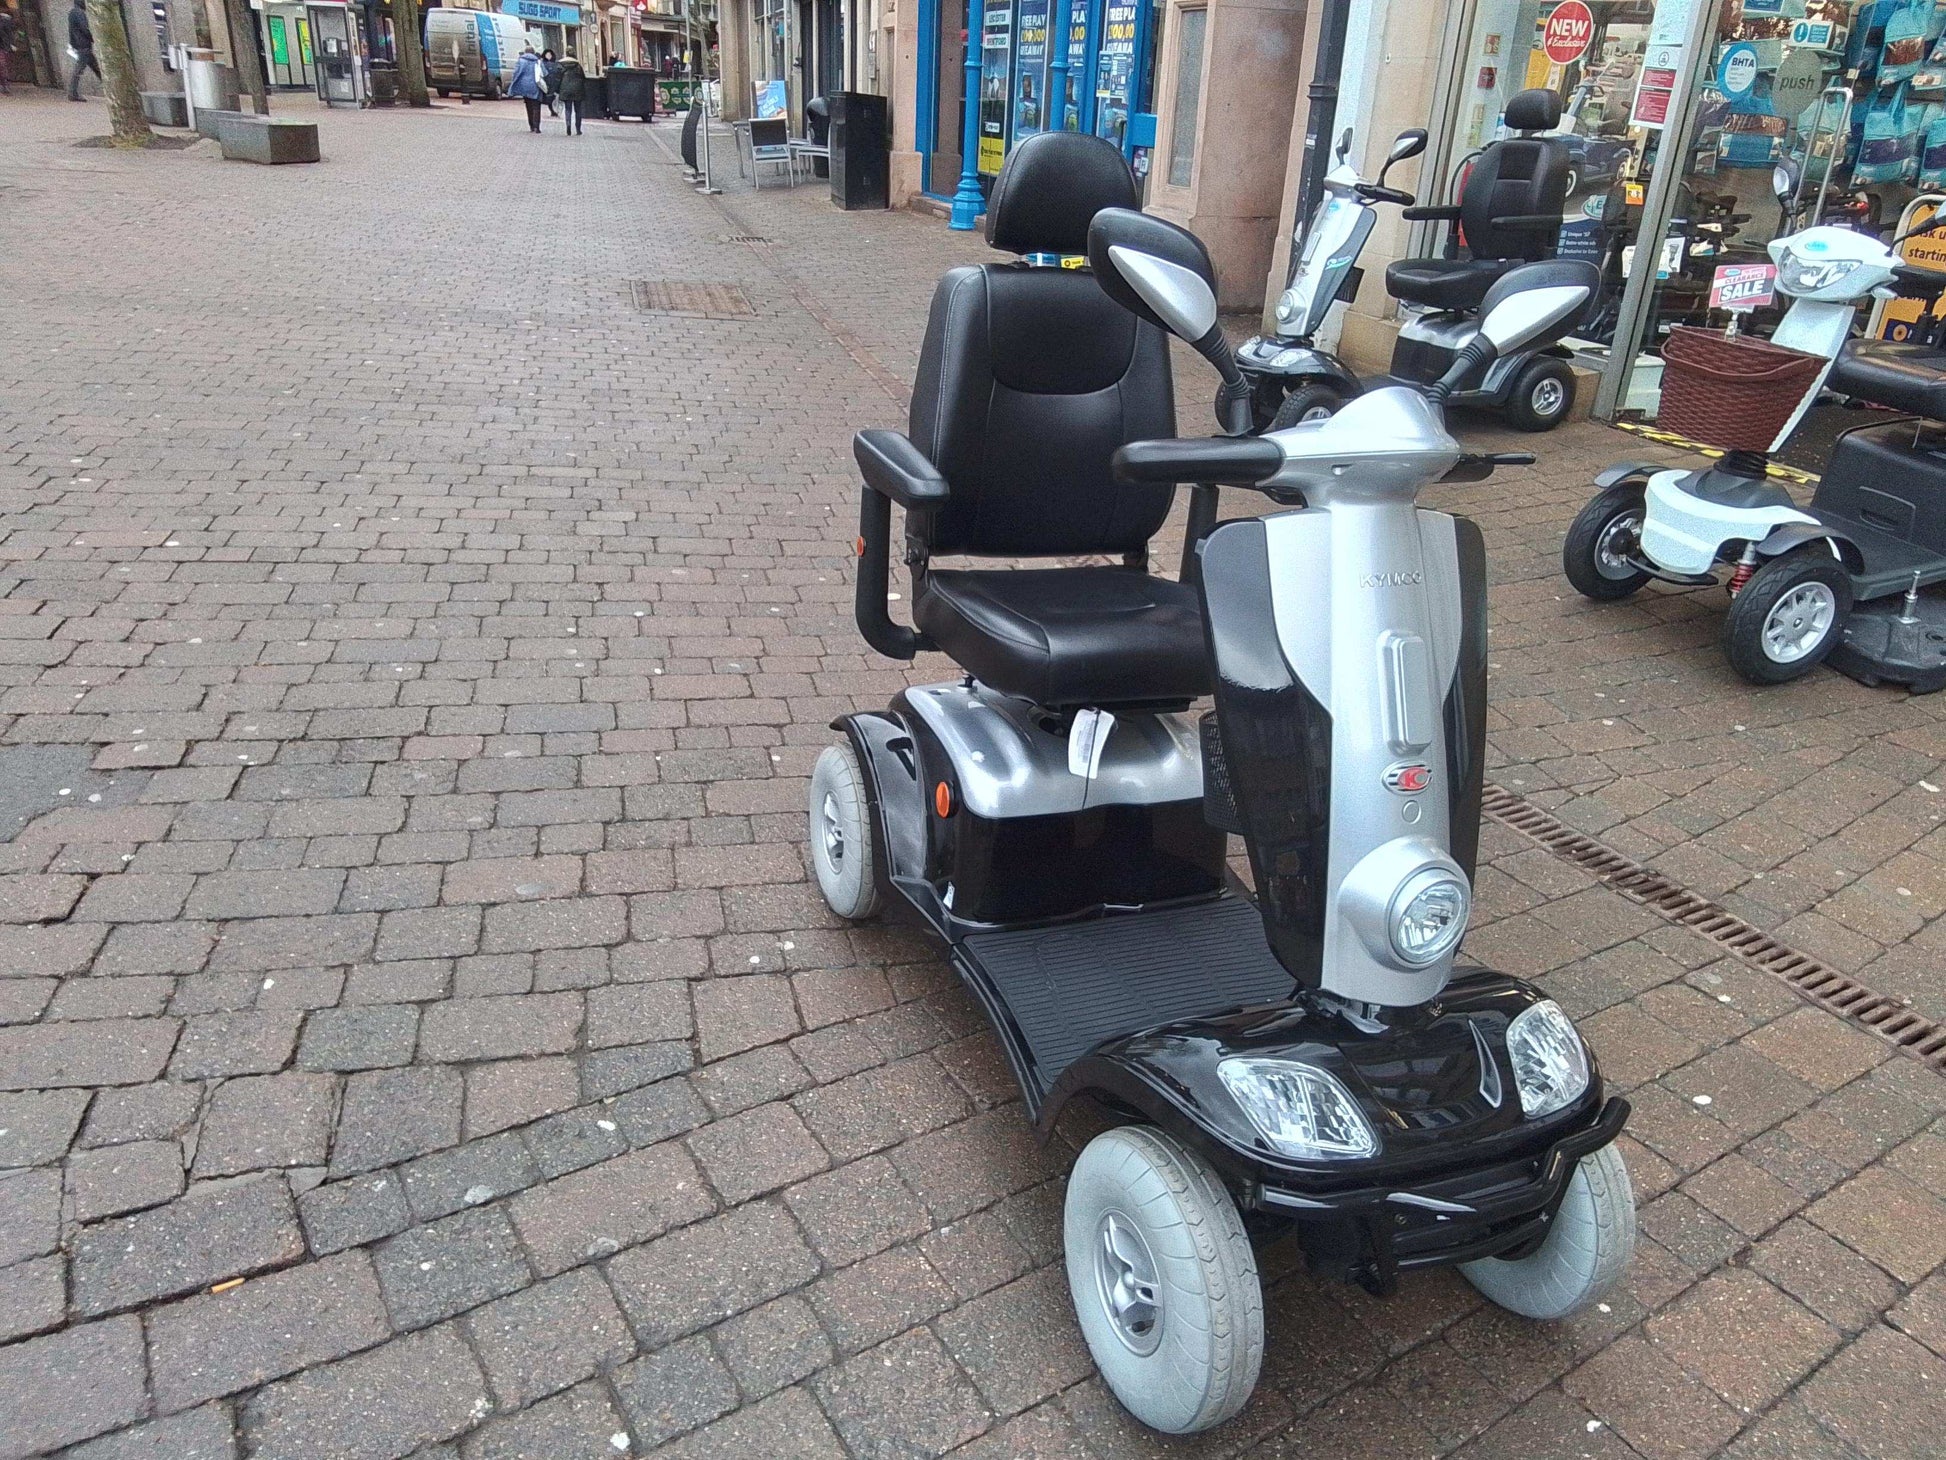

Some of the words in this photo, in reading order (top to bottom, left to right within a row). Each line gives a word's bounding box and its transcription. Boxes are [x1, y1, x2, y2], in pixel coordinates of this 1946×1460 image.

[518, 1, 539, 17] SUGG
[539, 6, 562, 20] SPORT
[1071, 9, 1087, 23] PLA
[1123, 6, 1136, 20] PLA
[1549, 18, 1590, 37] NEW
[1106, 42, 1133, 55] GIVEAWA
[1552, 35, 1586, 48] Exclusive
[1731, 57, 1755, 68] BHTA
[1779, 75, 1815, 91] push
[1725, 272, 1764, 284] CLEARANCE
[1720, 280, 1765, 301] SALE
[1359, 570, 1422, 588] KYMCO
